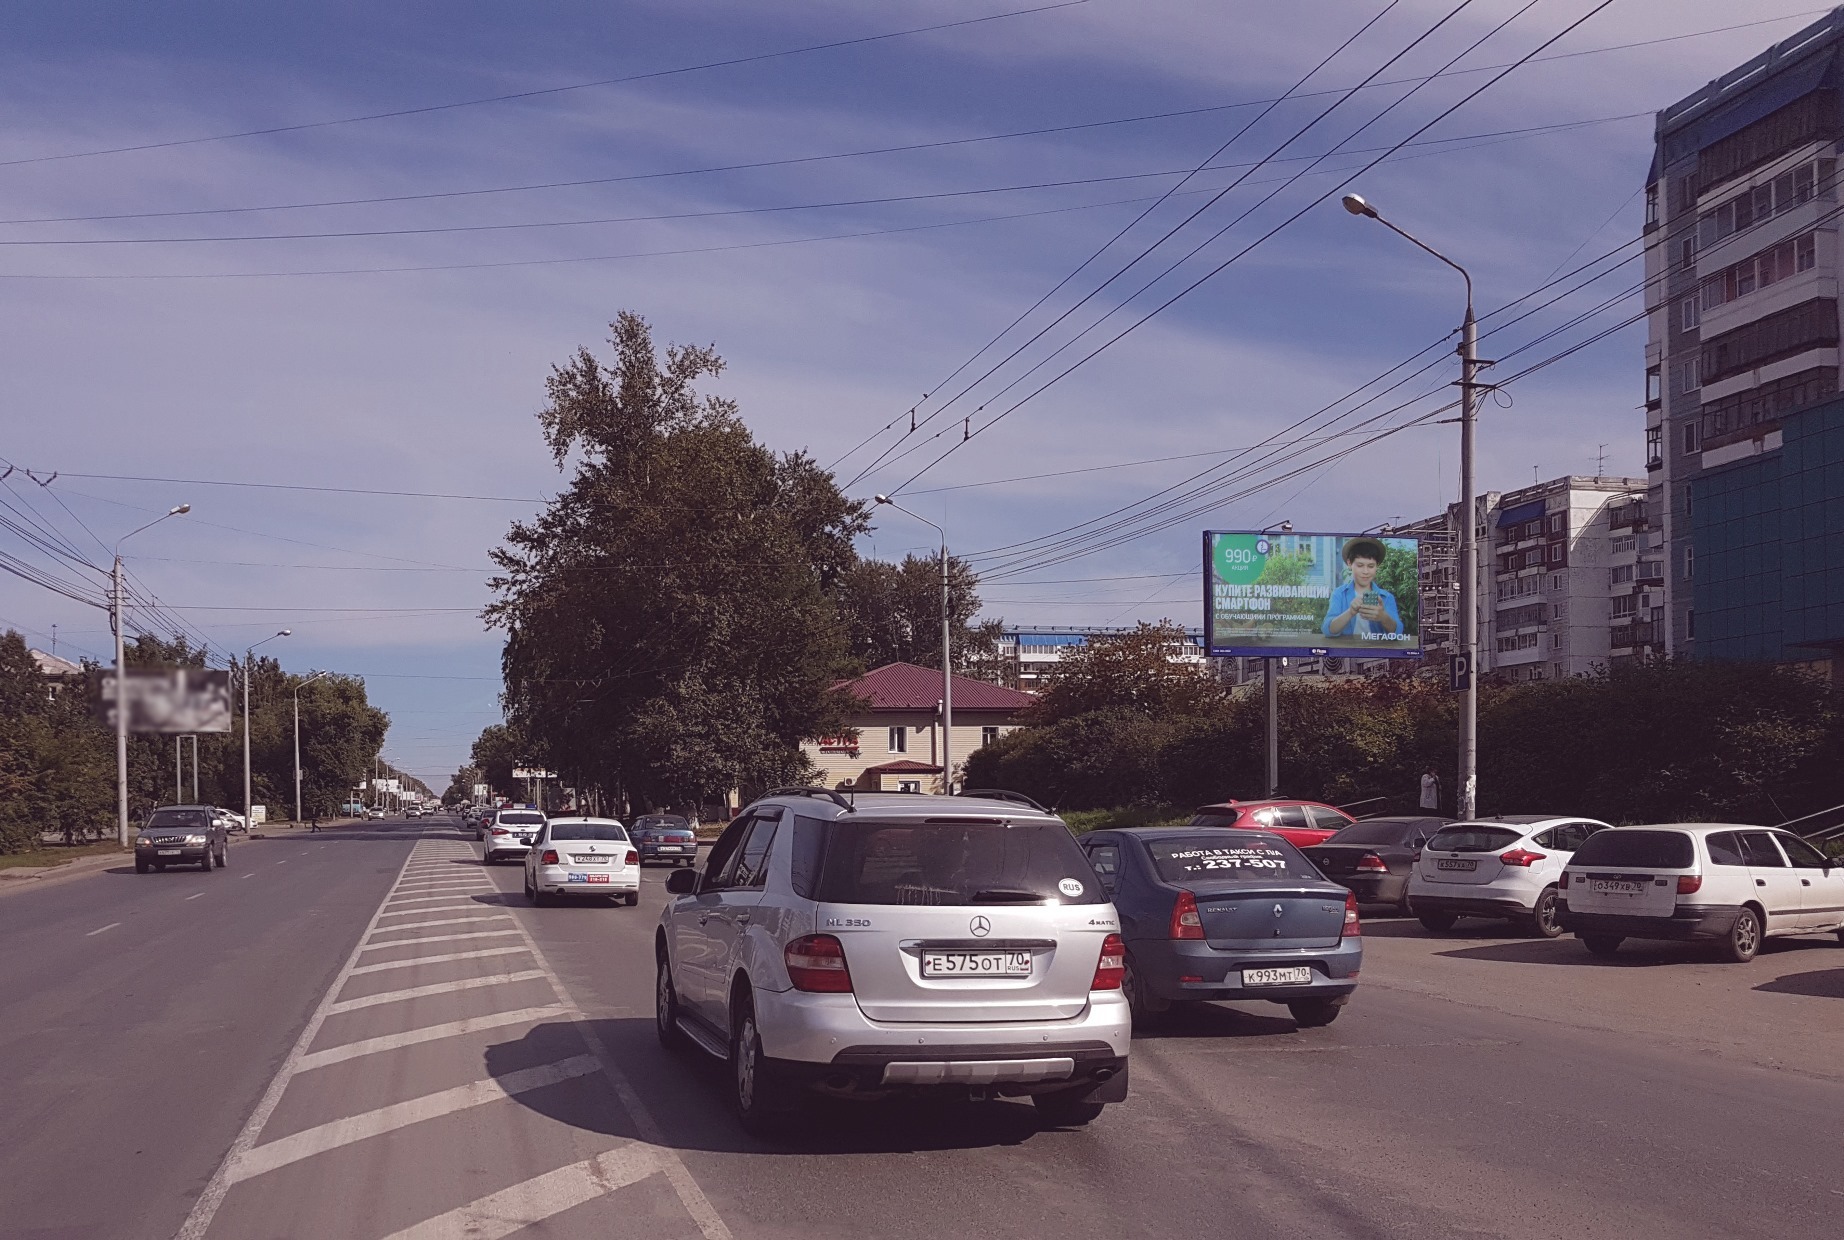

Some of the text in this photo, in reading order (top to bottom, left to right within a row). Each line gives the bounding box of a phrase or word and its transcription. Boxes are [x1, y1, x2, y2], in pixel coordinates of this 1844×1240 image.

[1225, 549, 1251, 563] 990
[1215, 585, 1253, 597] КУПИТЕ
[1215, 598, 1271, 610] СМАРТФОН
[1266, 613, 1314, 621] ПРОГРАММАМИ
[1171, 850, 1213, 859] РАБОТА
[1202, 859, 1286, 869] 237-507
[1062, 883, 1081, 892] RUS
[1007, 952, 1025, 966] 70
[1295, 967, 1307, 977] 70
